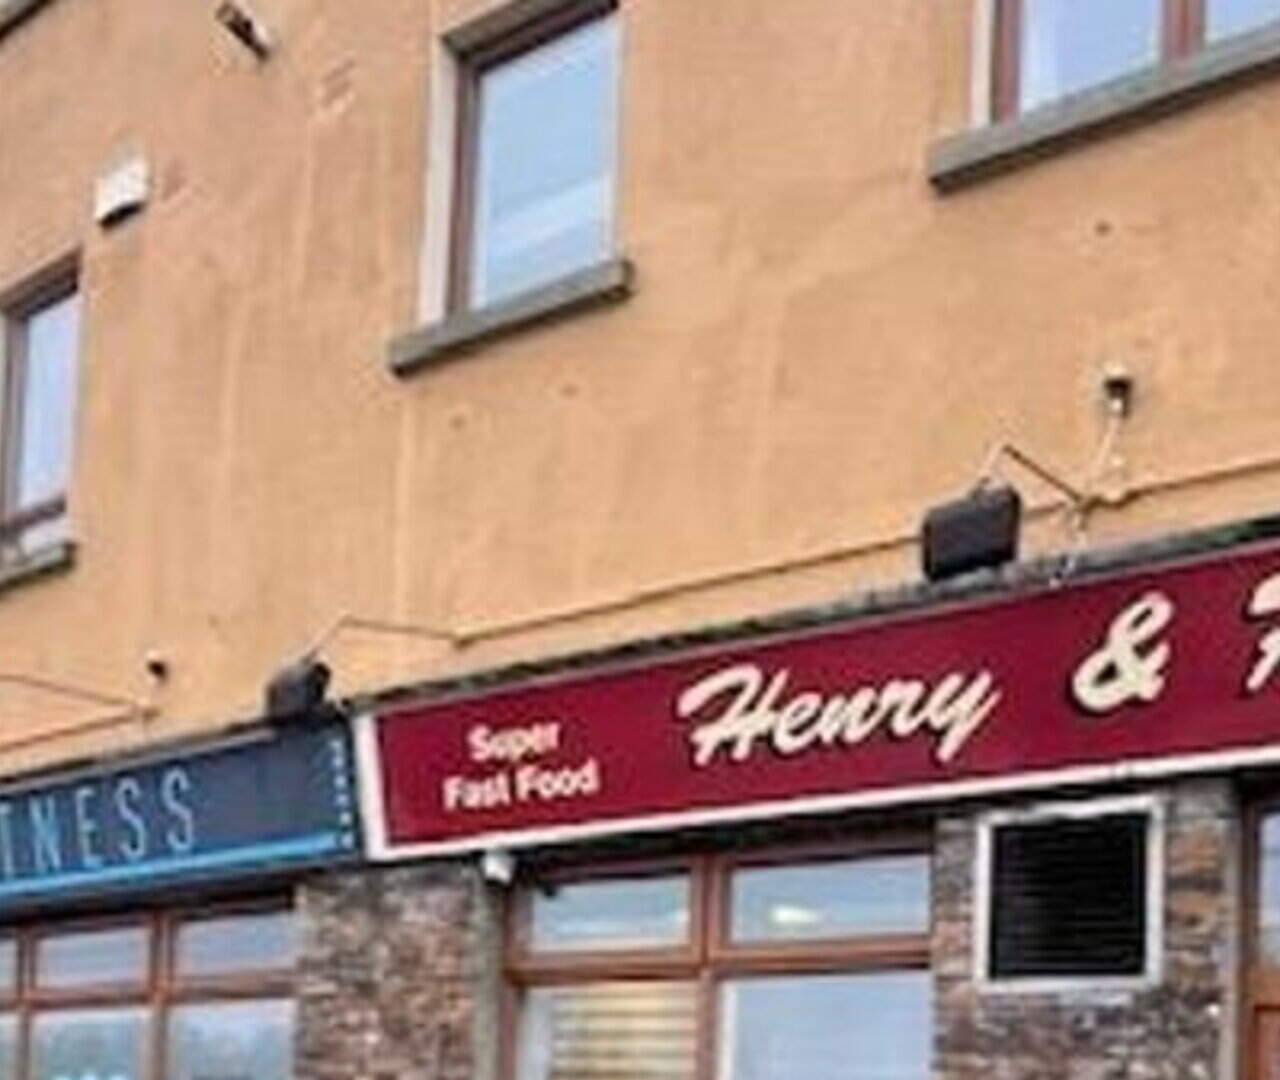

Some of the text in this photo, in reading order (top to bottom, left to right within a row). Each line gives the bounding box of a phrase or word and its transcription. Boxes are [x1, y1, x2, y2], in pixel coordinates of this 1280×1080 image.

[672, 662, 1000, 767] Henry
[1070, 590, 1178, 714] &
[467, 720, 561, 763] Super
[442, 755, 601, 812] Fast Food
